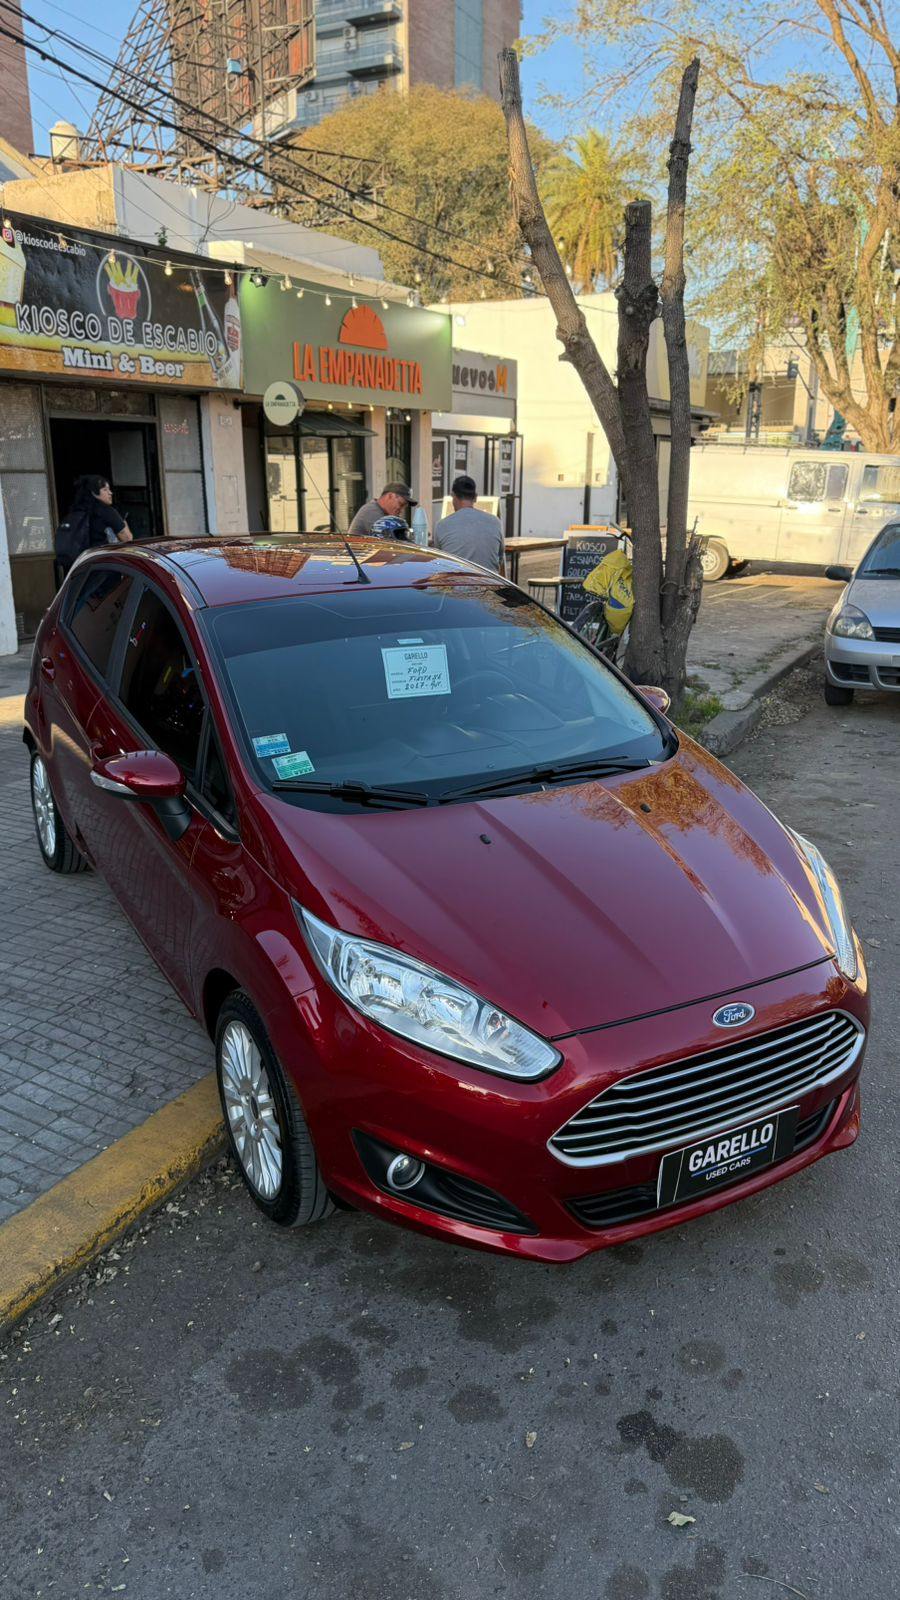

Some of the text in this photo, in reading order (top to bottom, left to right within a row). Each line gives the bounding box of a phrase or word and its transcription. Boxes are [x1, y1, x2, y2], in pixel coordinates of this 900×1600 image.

[15, 303, 102, 341] KIOSCO
[108, 317, 135, 345] DE
[142, 321, 219, 357] ESCABIO
[62, 346, 184, 378] Mini & Beer
[293, 342, 424, 395] LA EMPANADETTA
[577, 541, 606, 552] KIOSCO
[722, 1007, 747, 1023] Ford
[689, 1122, 775, 1172] GARELLO
[705, 1156, 751, 1181] USED CARS
